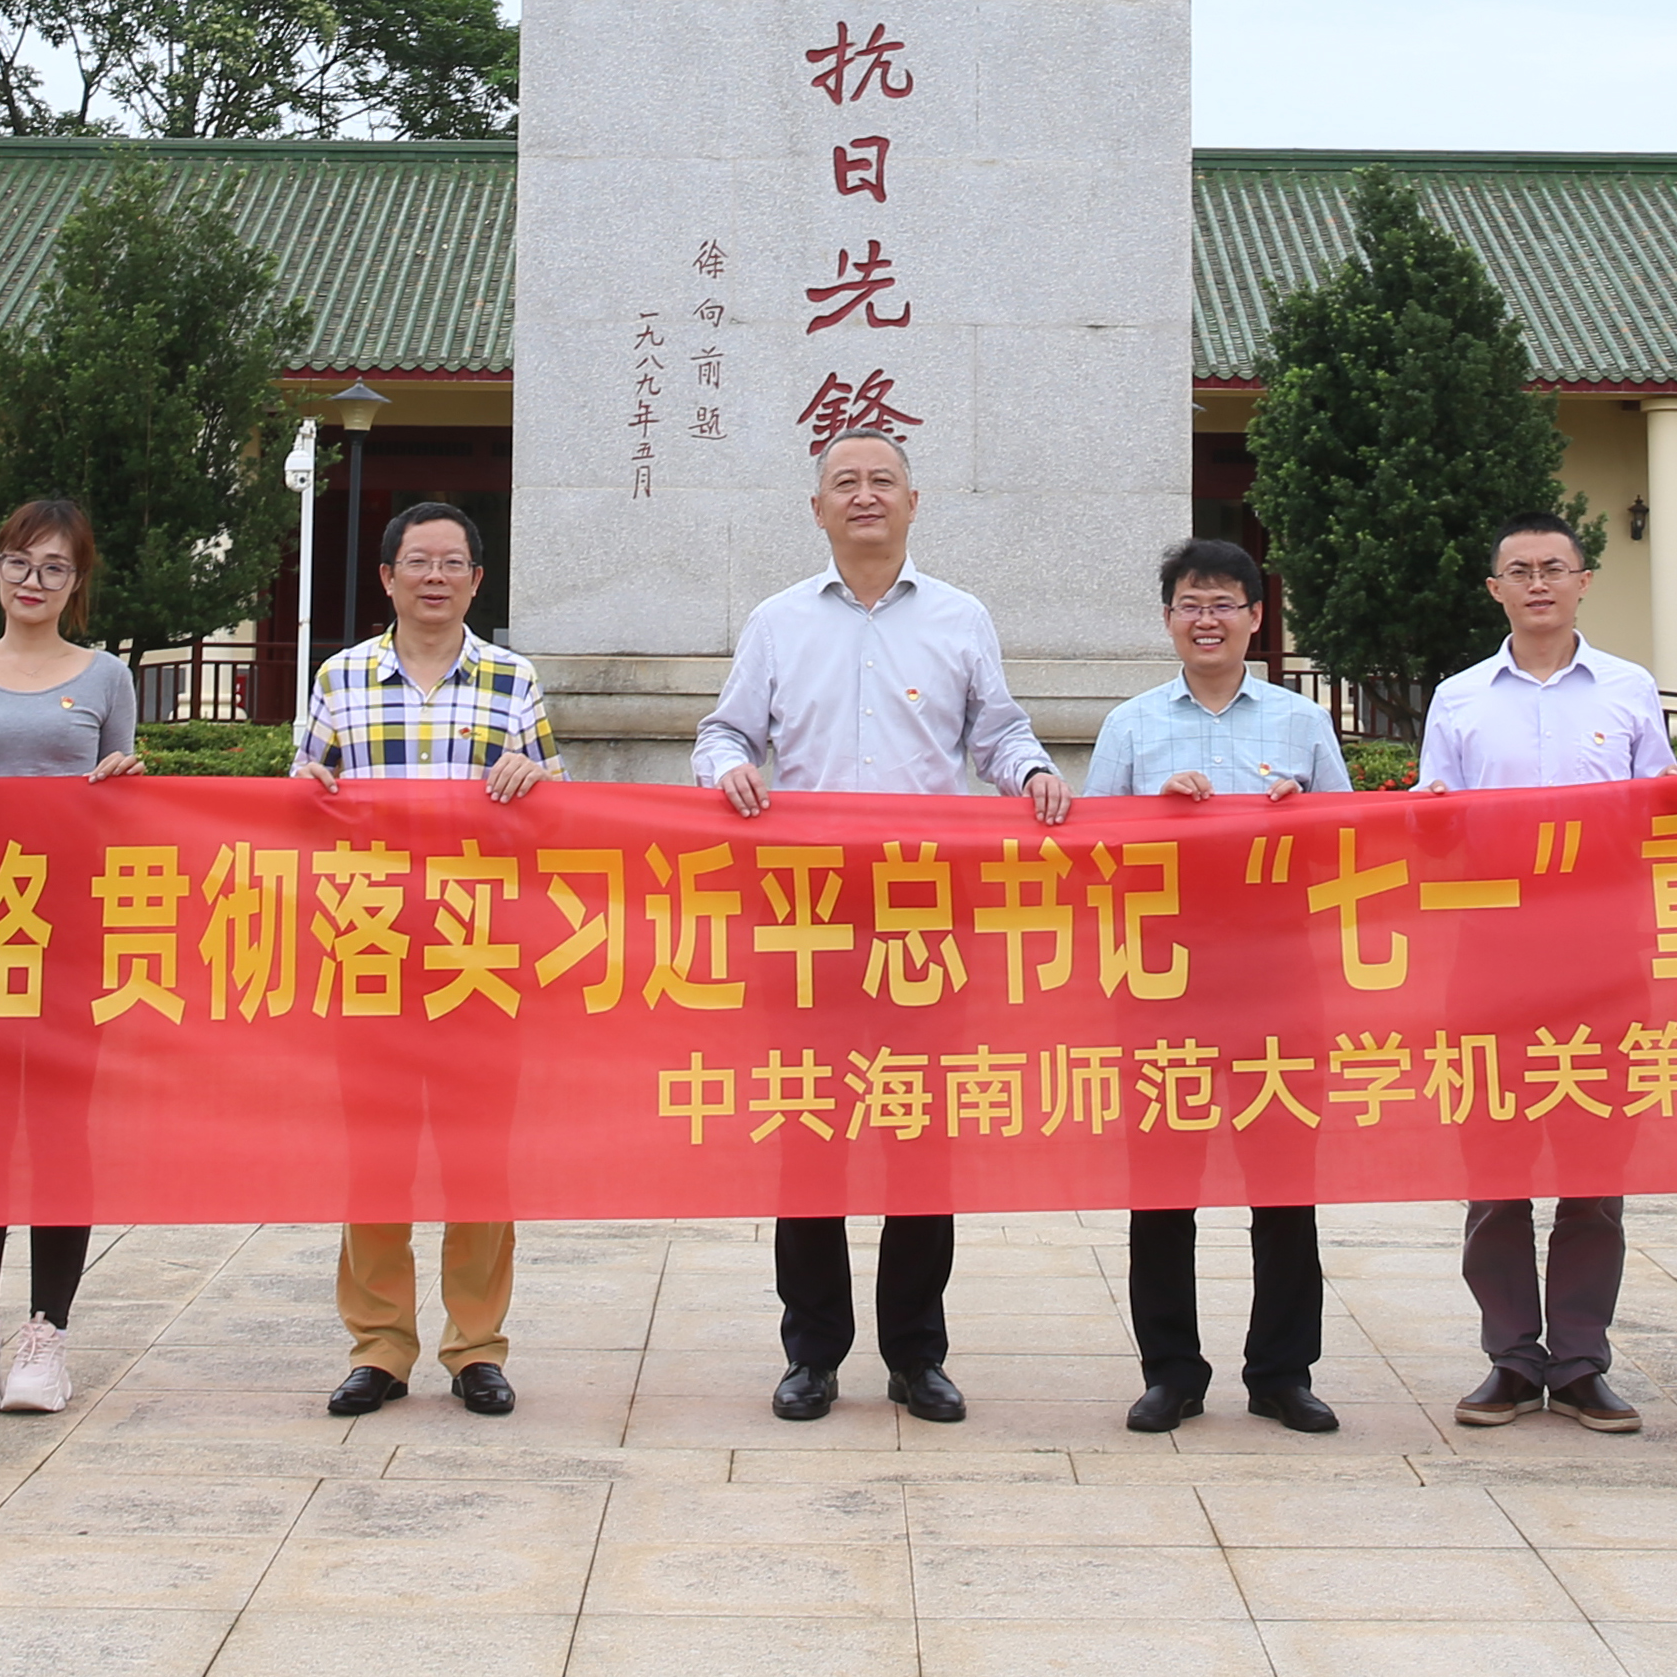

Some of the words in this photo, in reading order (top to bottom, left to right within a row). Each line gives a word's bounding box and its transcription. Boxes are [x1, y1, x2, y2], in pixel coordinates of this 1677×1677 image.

[628, 312, 665, 500] 一九八九年五月
